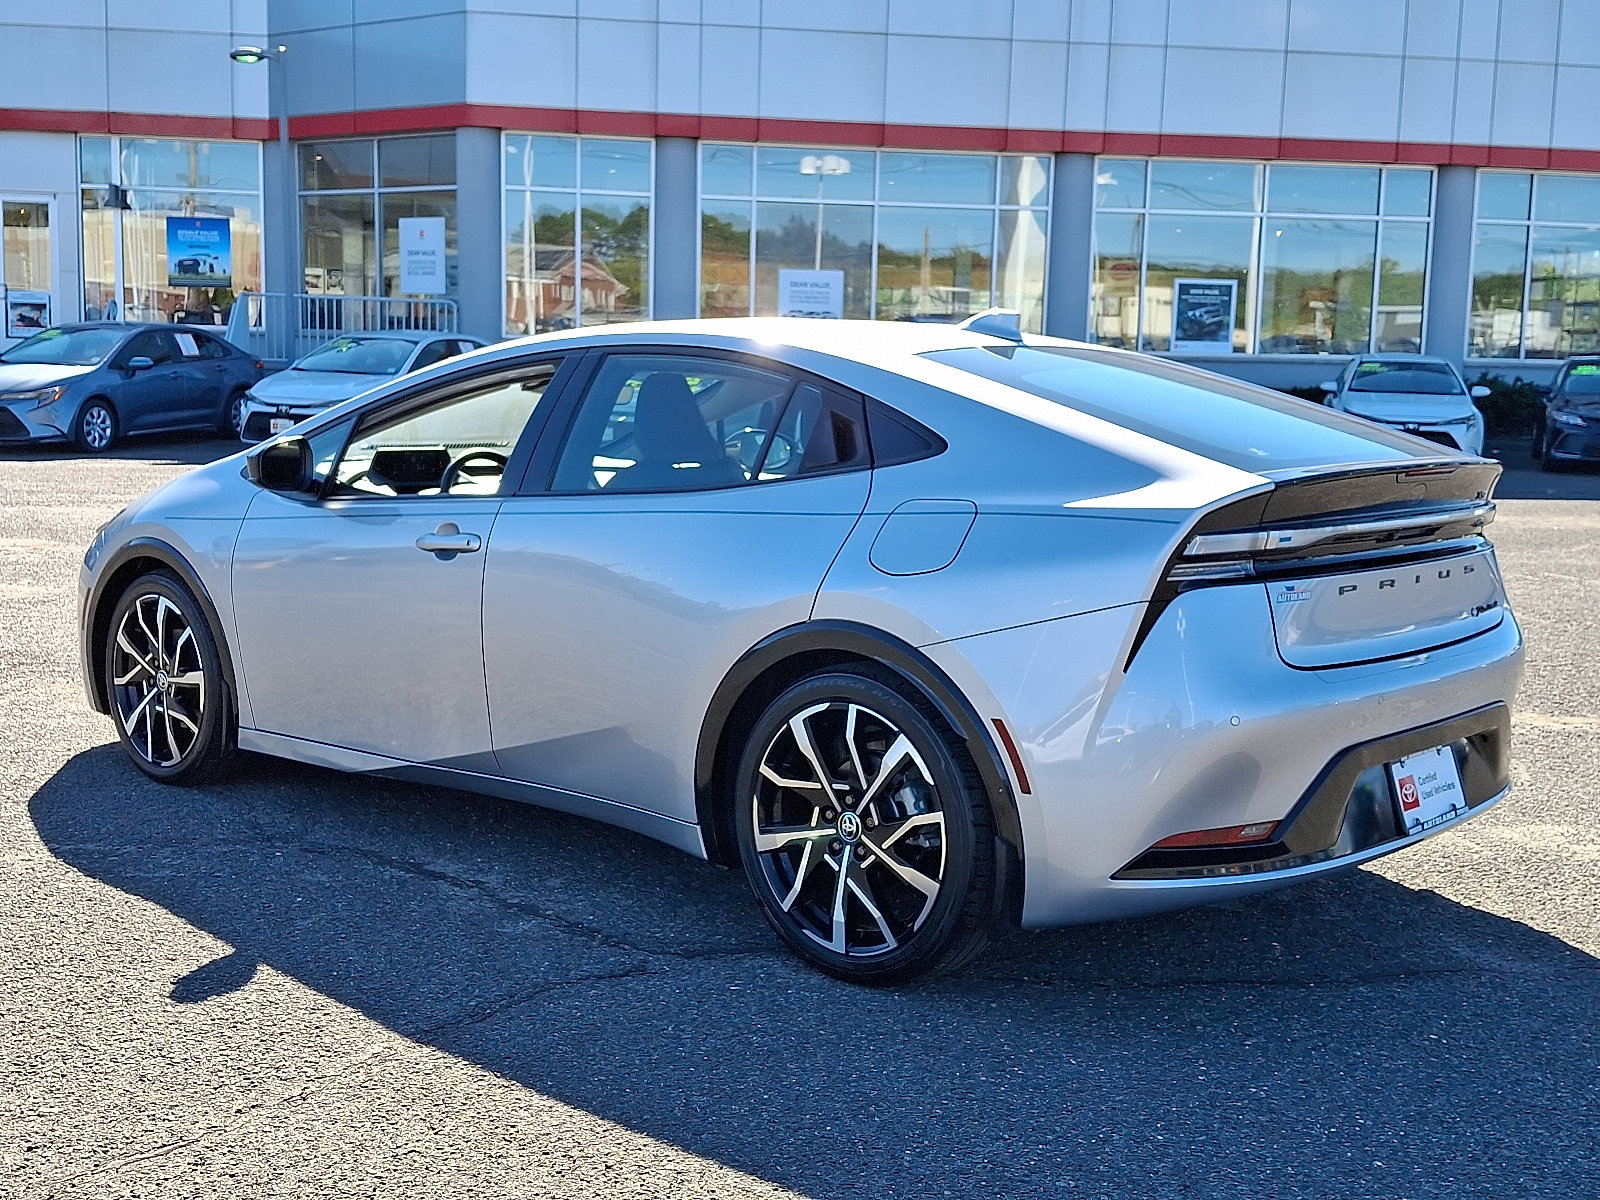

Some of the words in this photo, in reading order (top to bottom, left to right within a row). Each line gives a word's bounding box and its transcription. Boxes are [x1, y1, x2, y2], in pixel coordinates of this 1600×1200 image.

[1338, 564, 1475, 596] PRIUS
[1276, 592, 1311, 602] AUTOLAND
[1418, 771, 1437, 786] Certified
[1421, 788, 1434, 800] Used
[1434, 781, 1456, 796] Vehicles
[1423, 810, 1456, 830] AUTOLAND
